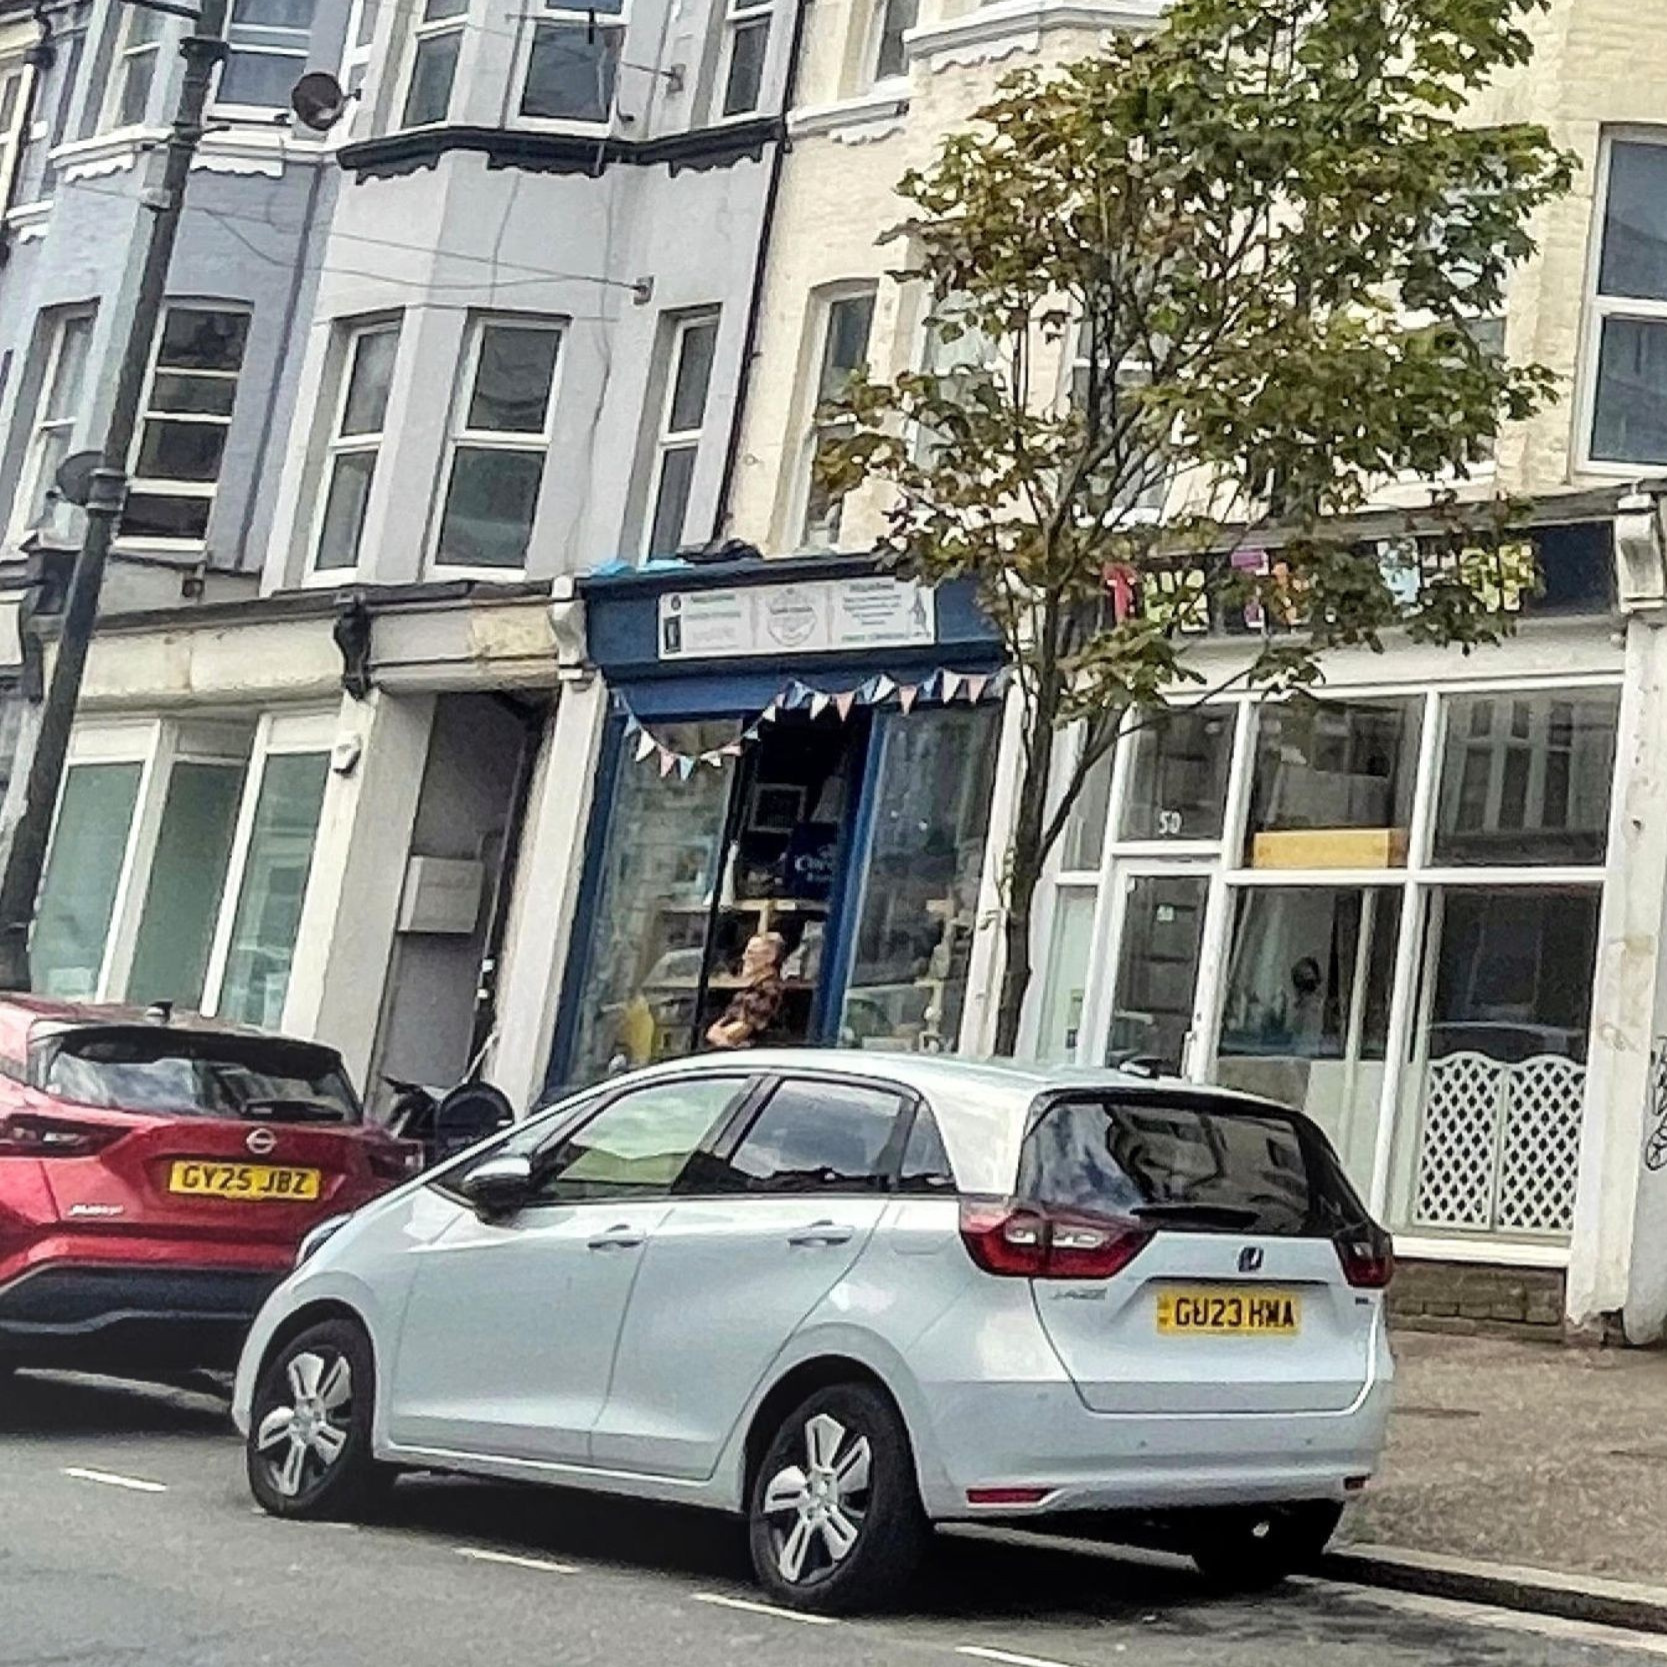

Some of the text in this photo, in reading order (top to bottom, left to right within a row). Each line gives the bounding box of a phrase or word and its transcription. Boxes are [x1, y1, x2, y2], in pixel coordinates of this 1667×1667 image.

[1159, 811, 1181, 834] 50
[181, 1165, 251, 1193] GY25
[1175, 1297, 1242, 1327] GU23
